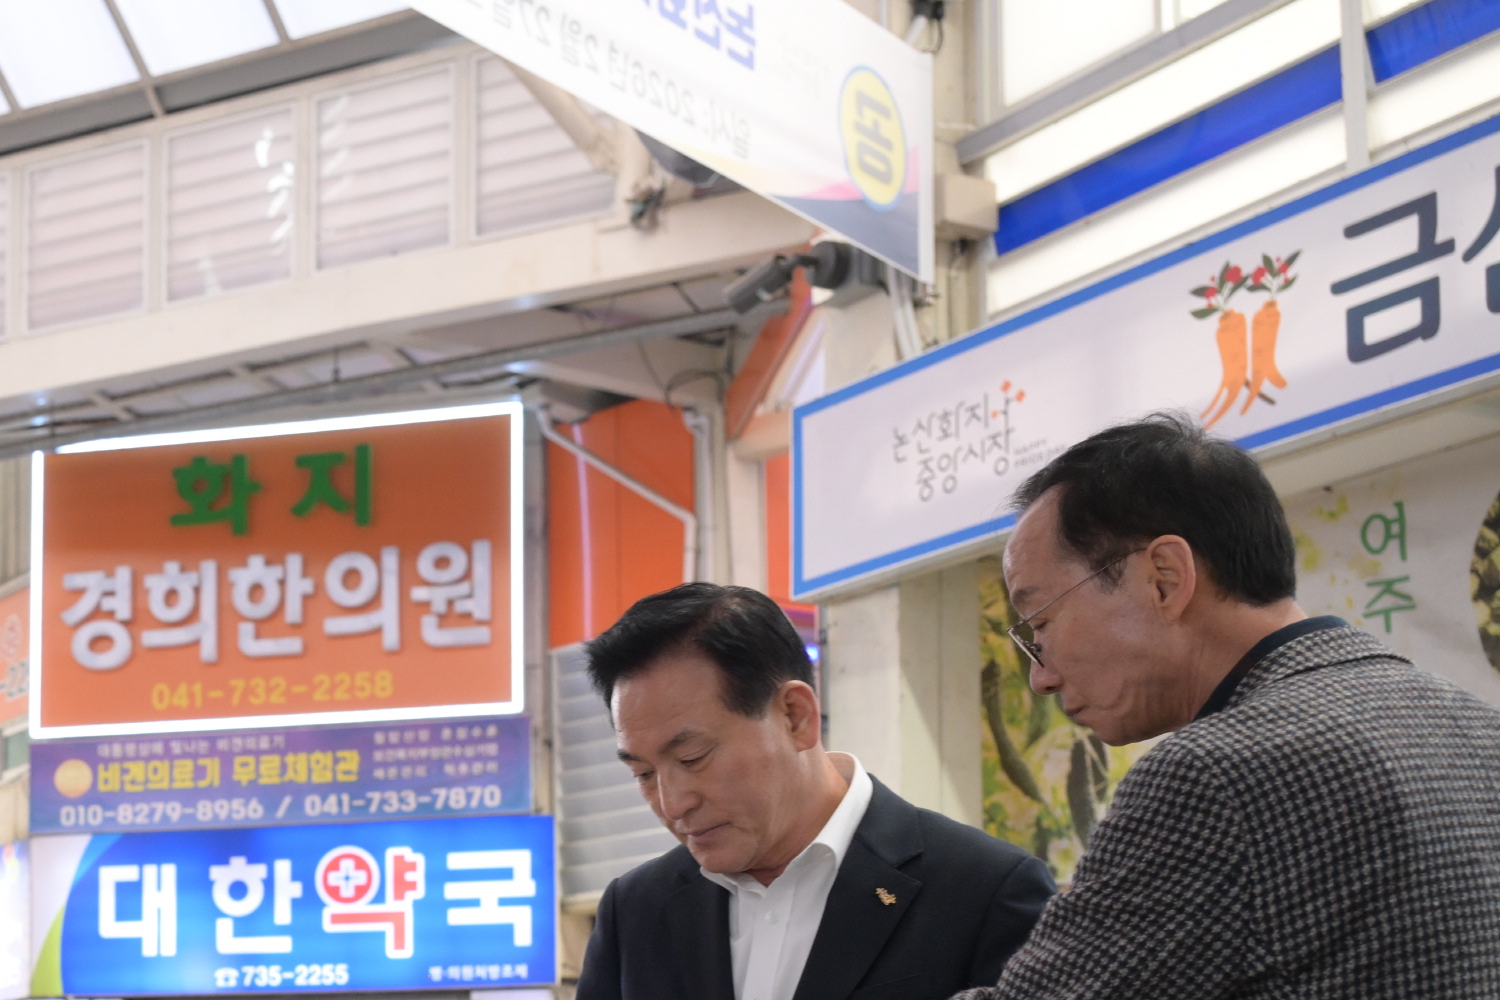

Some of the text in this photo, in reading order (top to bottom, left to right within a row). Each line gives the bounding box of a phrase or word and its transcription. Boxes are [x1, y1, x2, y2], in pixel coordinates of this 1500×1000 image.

[893, 392, 989, 462] 논산화지
[916, 398, 1015, 501] 중앙시장
[1360, 501, 1416, 634] 여주
[60, 538, 493, 671] 경희한의원
[151, 670, 394, 713] 041-732-2258
[232, 750, 361, 788] 무료체험관
[60, 792, 264, 827] 010-8279-8956
[304, 784, 502, 817] 041-733-7870
[98, 845, 537, 959] 대한약국
[241, 964, 349, 987] 735-2255
